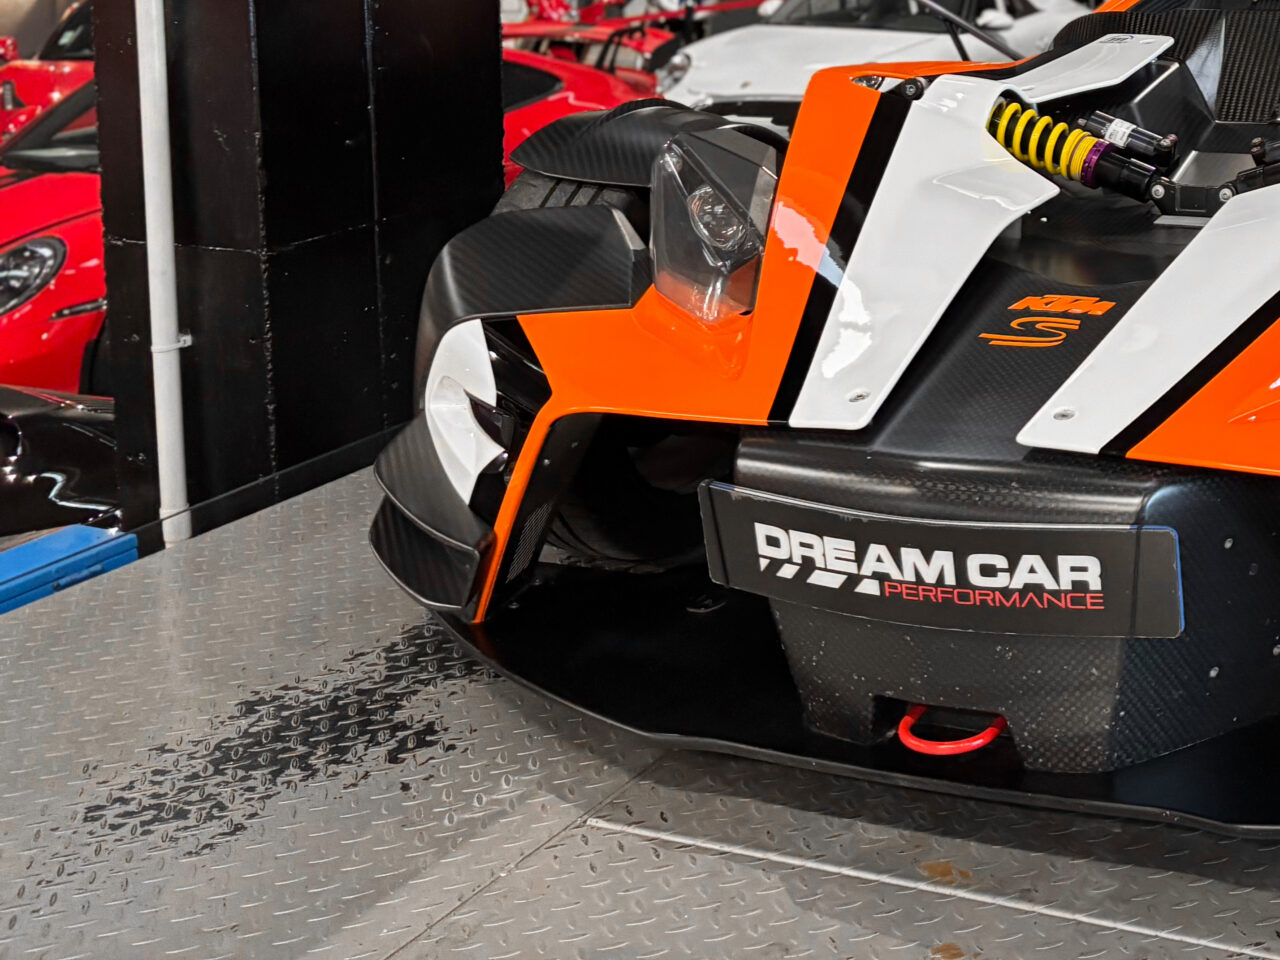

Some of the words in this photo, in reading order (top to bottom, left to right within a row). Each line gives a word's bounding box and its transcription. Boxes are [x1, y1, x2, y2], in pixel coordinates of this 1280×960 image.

[1008, 295, 1117, 316] KTM
[754, 522, 956, 586] DREAM
[967, 554, 1102, 591] CAR
[884, 581, 1105, 610] PERFORMANCE
